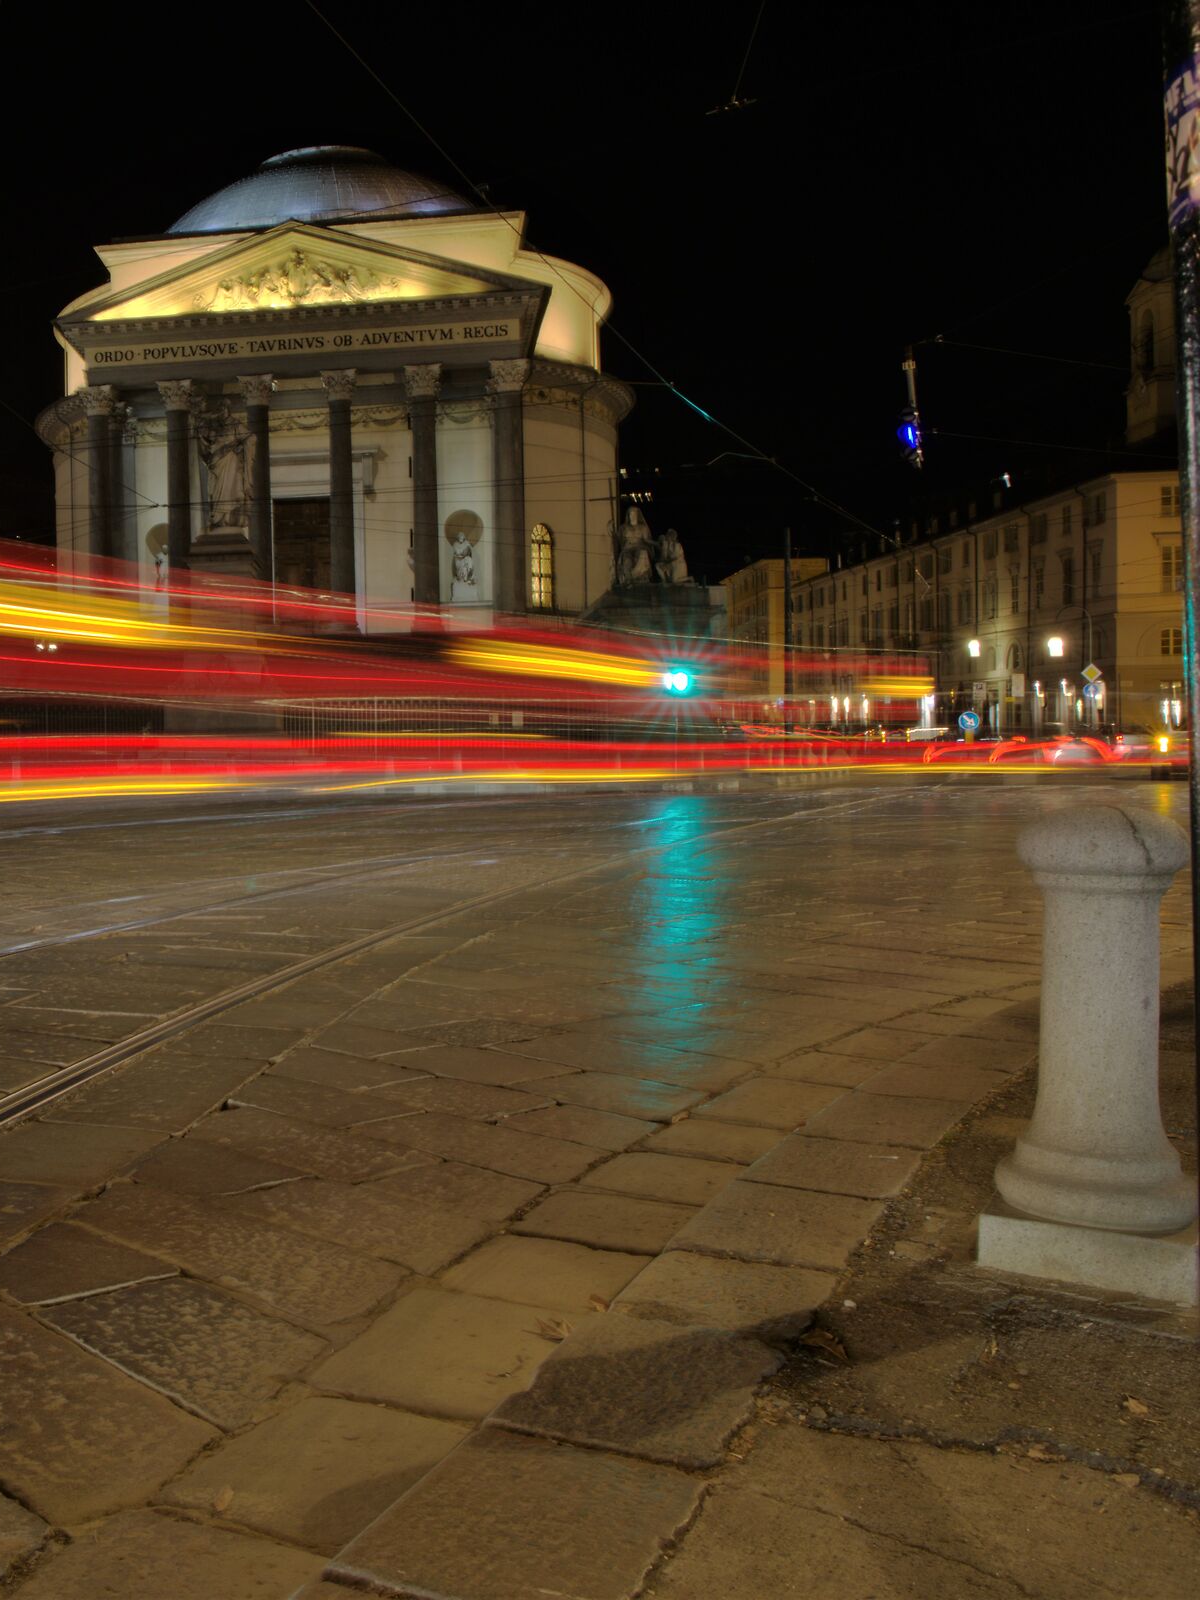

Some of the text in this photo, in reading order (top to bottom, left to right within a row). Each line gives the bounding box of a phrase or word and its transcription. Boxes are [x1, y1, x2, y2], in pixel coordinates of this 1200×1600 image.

[94, 324, 509, 364] ORDO POPVLVSQVE TAVRINVS OB ADVENTVM REGIS
